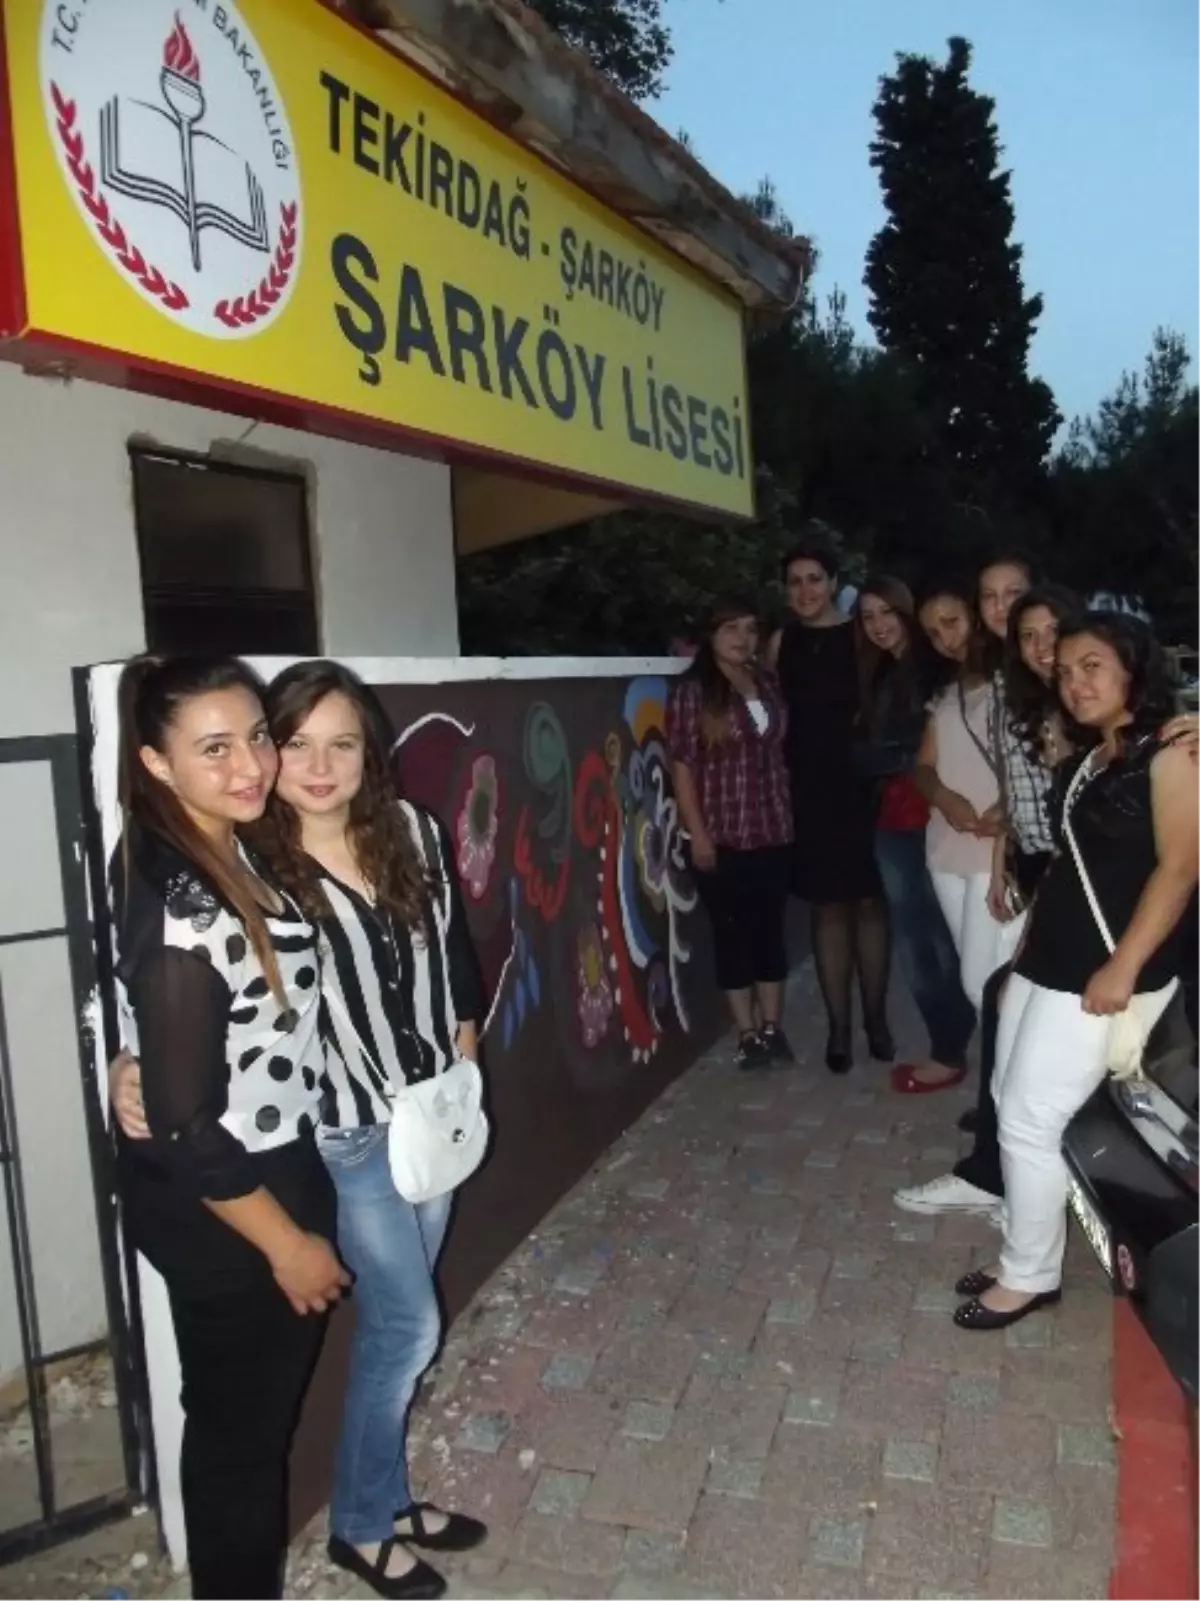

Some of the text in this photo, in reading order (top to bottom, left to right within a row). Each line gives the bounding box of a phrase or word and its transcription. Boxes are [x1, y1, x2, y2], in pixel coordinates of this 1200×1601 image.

[320, 71, 530, 261] TEKİRDAĞ
[560, 226, 665, 332] ŞARKÖY
[331, 233, 745, 479] ŞARKÖY LİSESİ
